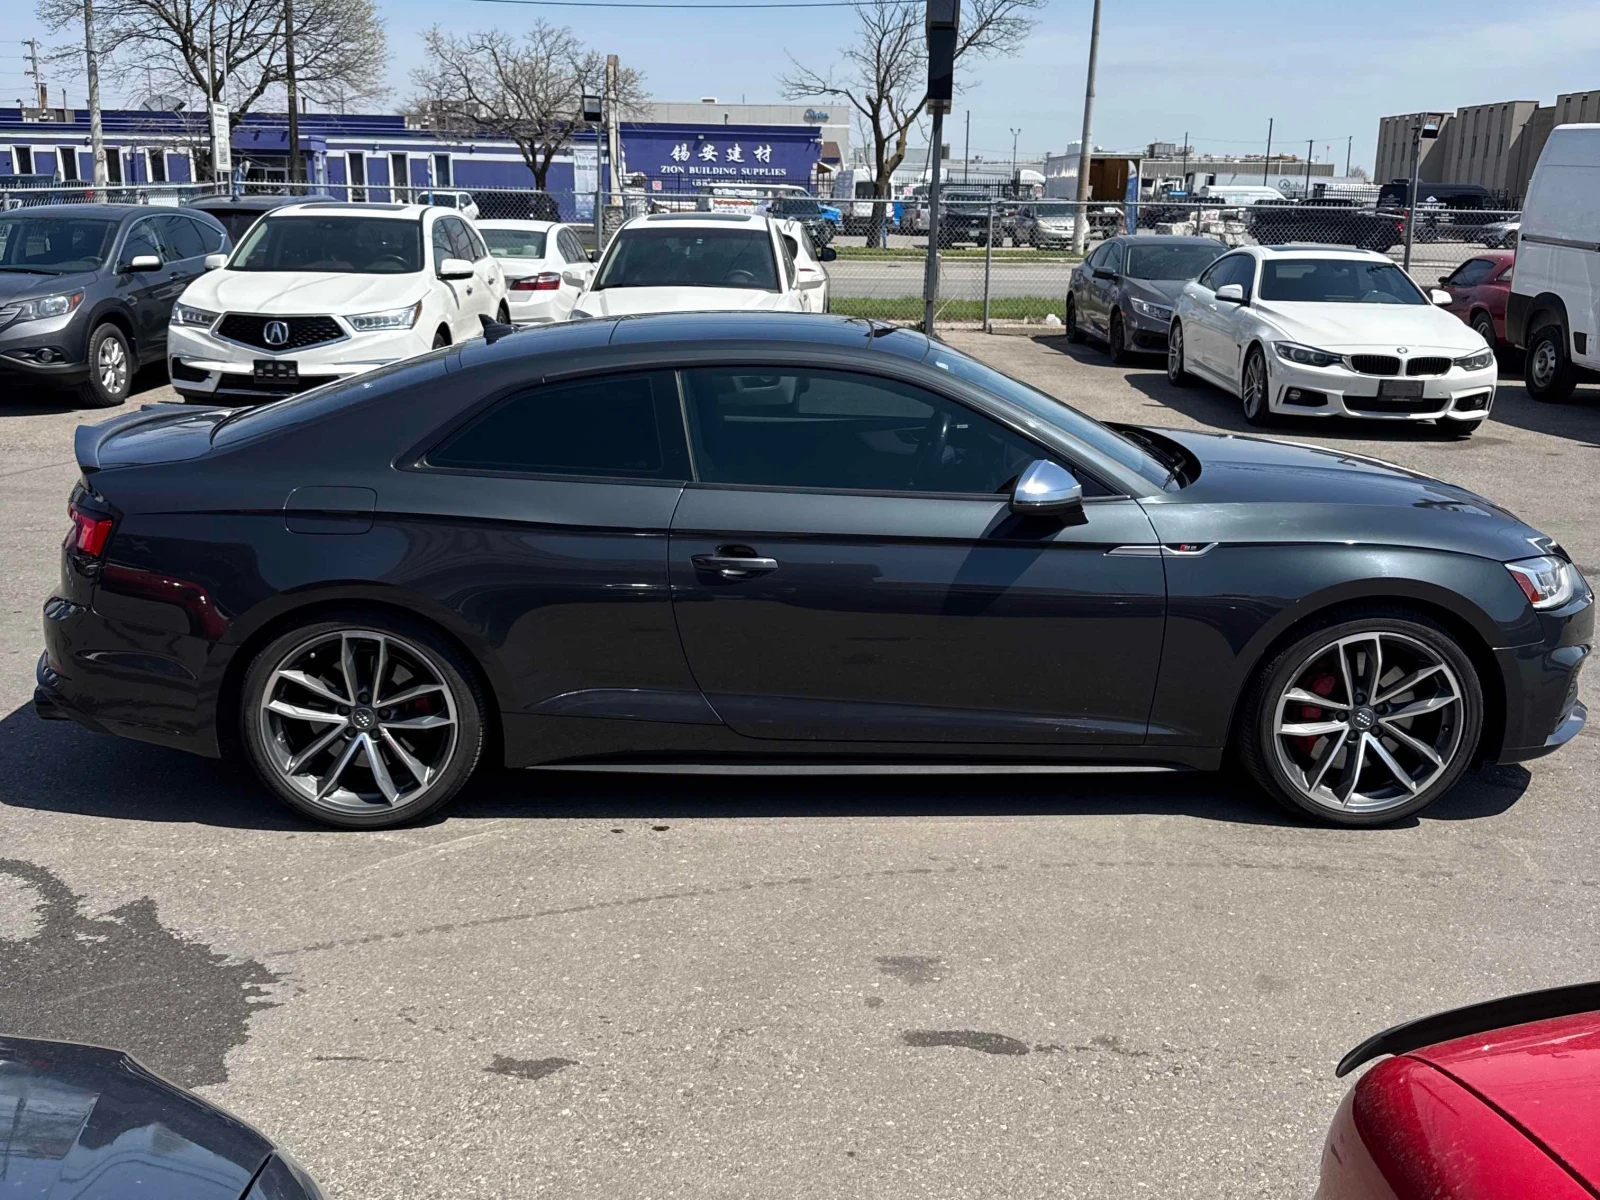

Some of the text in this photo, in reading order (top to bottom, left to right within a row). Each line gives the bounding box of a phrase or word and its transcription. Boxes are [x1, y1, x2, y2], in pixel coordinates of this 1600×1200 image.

[660, 165, 787, 176] ZION BUILDING SUPPLIES
